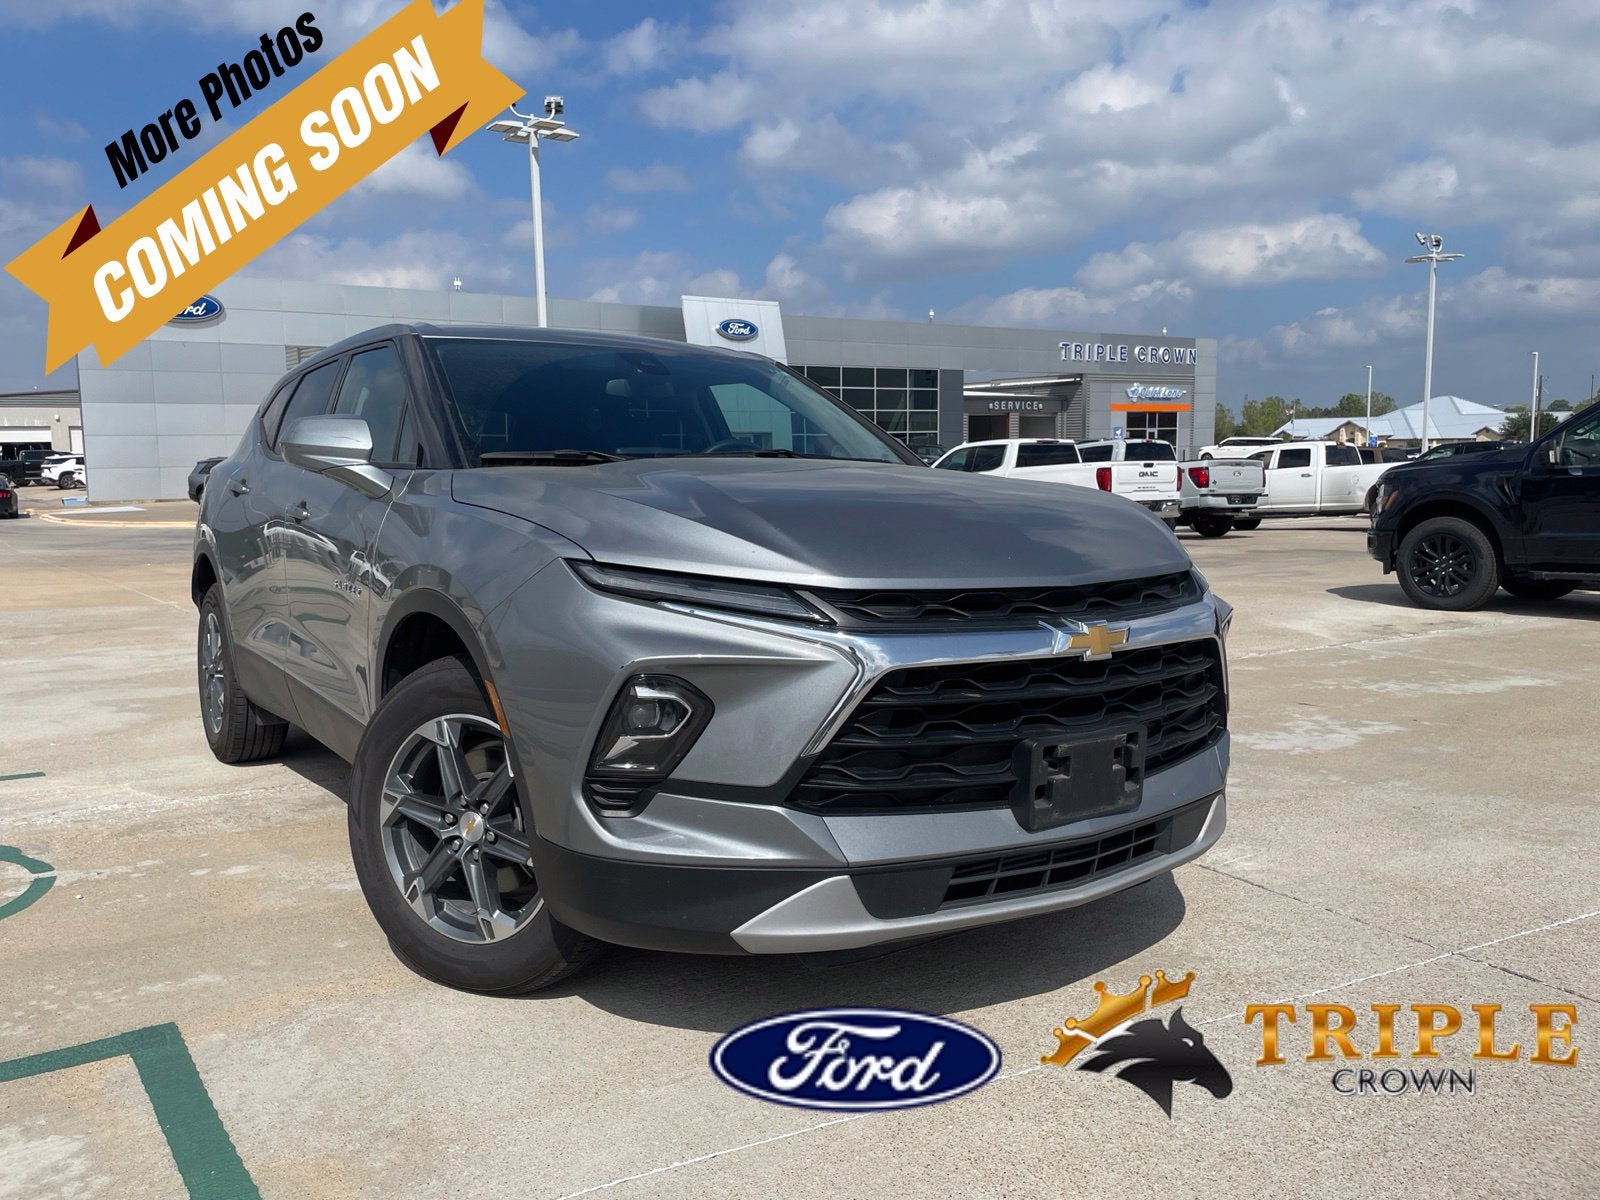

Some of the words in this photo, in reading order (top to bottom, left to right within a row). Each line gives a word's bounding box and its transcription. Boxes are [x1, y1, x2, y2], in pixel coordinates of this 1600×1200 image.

[727, 322, 751, 335] Ford
[1059, 342, 1128, 362] TRIPLE
[1134, 346, 1198, 365] CROWN
[994, 400, 1038, 410] SERVICE
